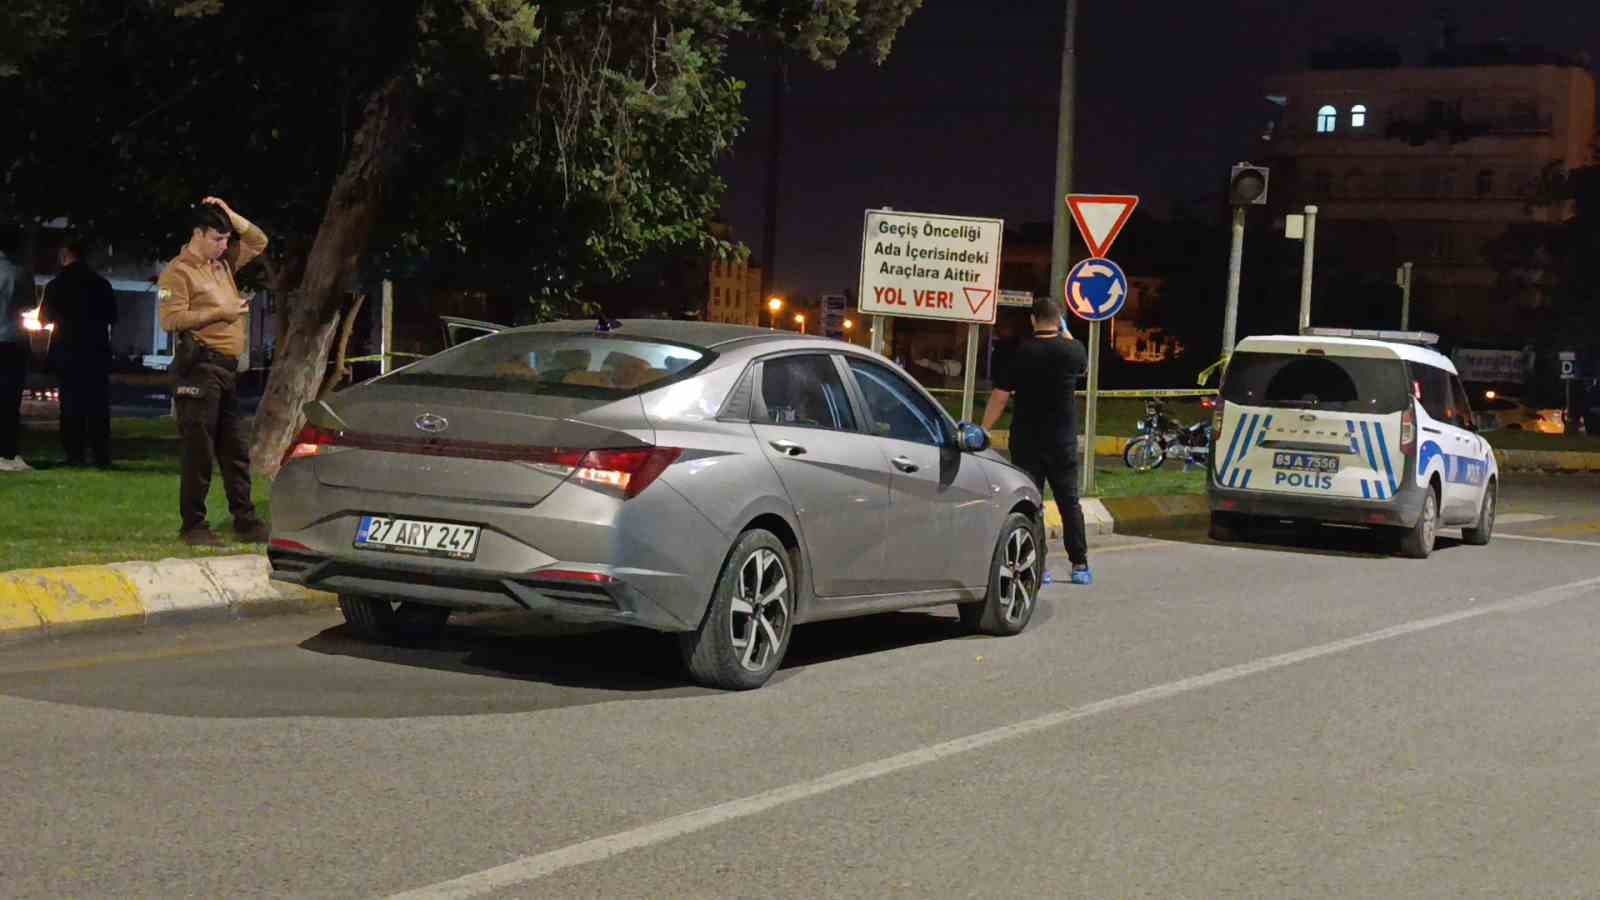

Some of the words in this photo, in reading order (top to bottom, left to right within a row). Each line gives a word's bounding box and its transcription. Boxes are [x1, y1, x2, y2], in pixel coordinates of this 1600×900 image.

[879, 221, 918, 238] Geçiş
[923, 221, 981, 242] Önceliği
[874, 242, 901, 256] Ada
[906, 243, 989, 264] İçerisindeki
[879, 262, 940, 279] Araçlara
[944, 267, 981, 283] Aittir
[873, 286, 907, 306] YOL
[913, 289, 954, 309] VER!
[1294, 456, 1303, 467] A
[1275, 471, 1332, 489] POLİS
[369, 519, 394, 542] 27
[395, 522, 433, 546] ARY
[437, 526, 474, 550] 247
